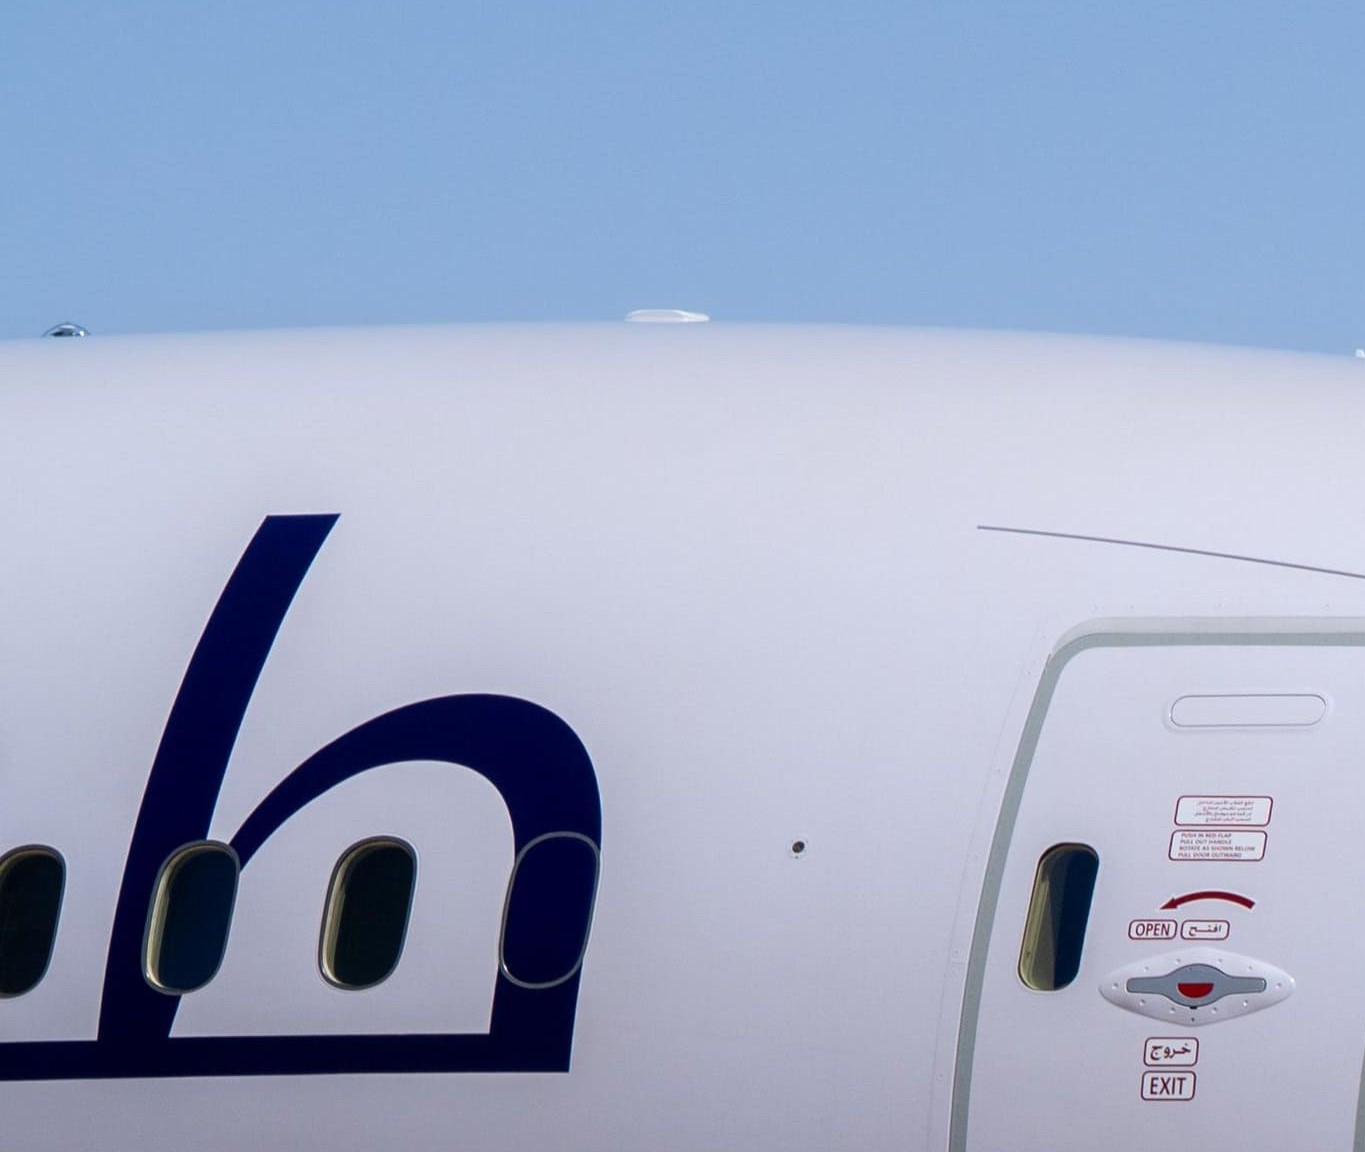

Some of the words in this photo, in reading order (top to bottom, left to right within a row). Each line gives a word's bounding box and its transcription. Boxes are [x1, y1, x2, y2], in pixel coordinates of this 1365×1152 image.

[1135, 923, 1170, 936] OPEN
[1150, 1043, 1191, 1061] خروج
[1150, 1077, 1187, 1095] EXIT
